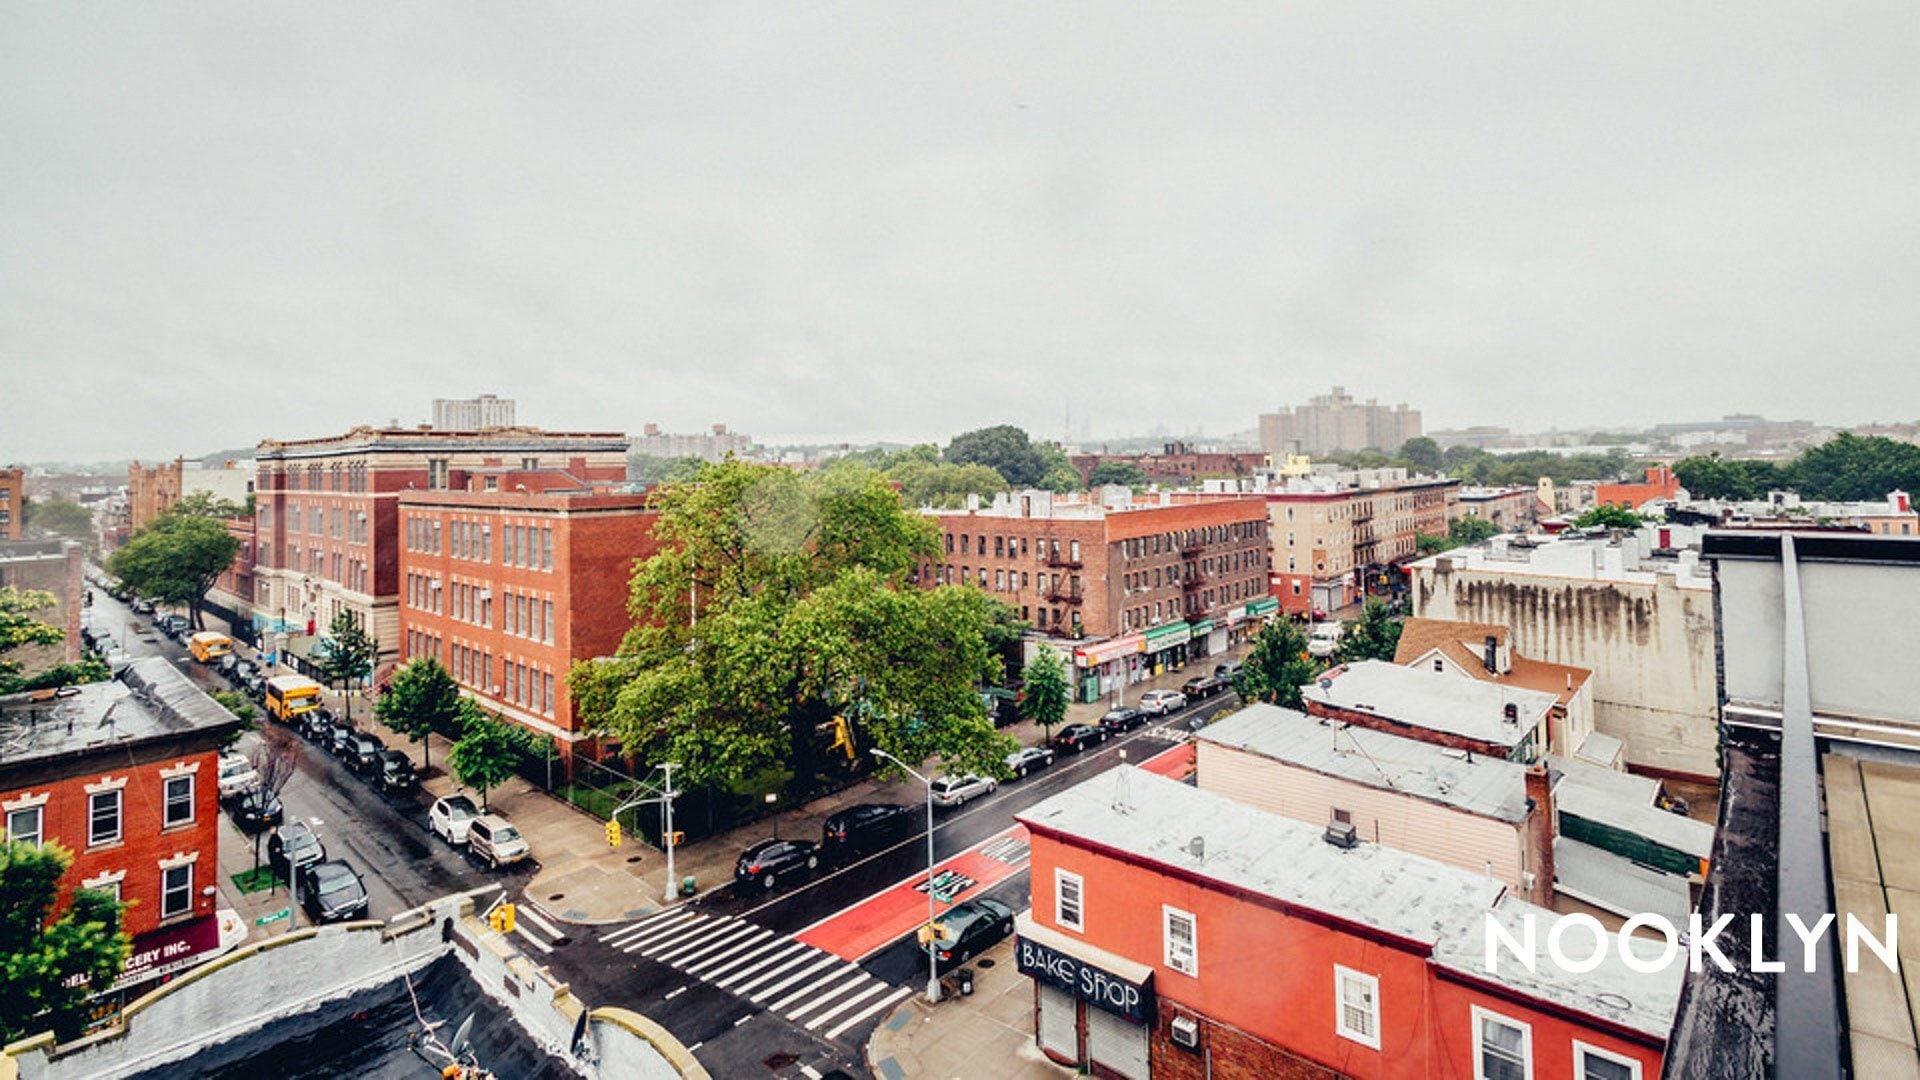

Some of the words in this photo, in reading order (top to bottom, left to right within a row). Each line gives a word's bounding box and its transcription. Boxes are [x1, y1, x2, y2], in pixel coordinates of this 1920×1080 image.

[163, 941, 191, 958] INC.
[1022, 943, 1075, 984] BAKE
[1079, 967, 1139, 1014] SHOP
